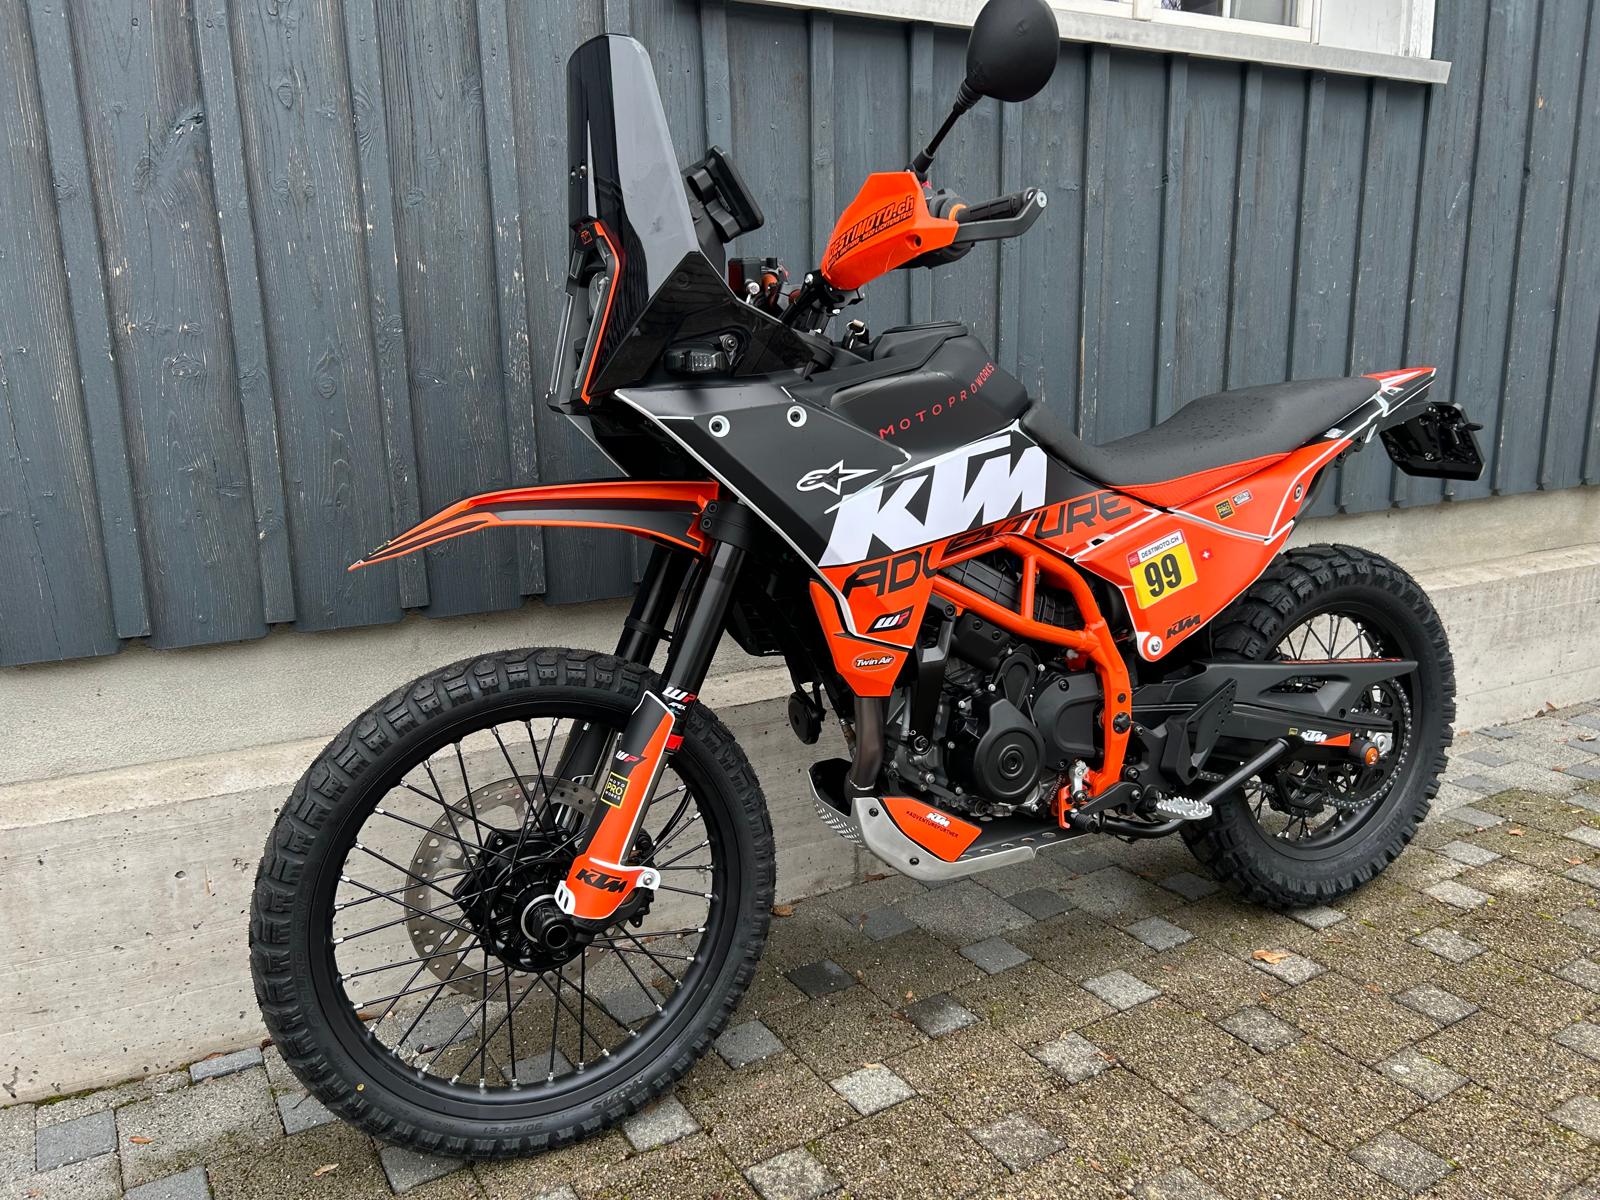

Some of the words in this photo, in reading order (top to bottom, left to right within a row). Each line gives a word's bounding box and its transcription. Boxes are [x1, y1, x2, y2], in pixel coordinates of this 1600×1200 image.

[817, 434, 1048, 567] KTM
[1141, 535, 1180, 559] DESTIMOTO.CH
[1144, 553, 1182, 598] 99
[874, 611, 910, 629] WP
[1166, 615, 1200, 639] KTM
[856, 659, 878, 667] Twin
[878, 656, 894, 664] Air
[661, 686, 697, 703] WP
[1301, 729, 1328, 743] KTM
[616, 750, 640, 762] WP
[606, 782, 624, 796] PRO
[926, 812, 951, 827] KTM
[575, 868, 628, 893] KTM
